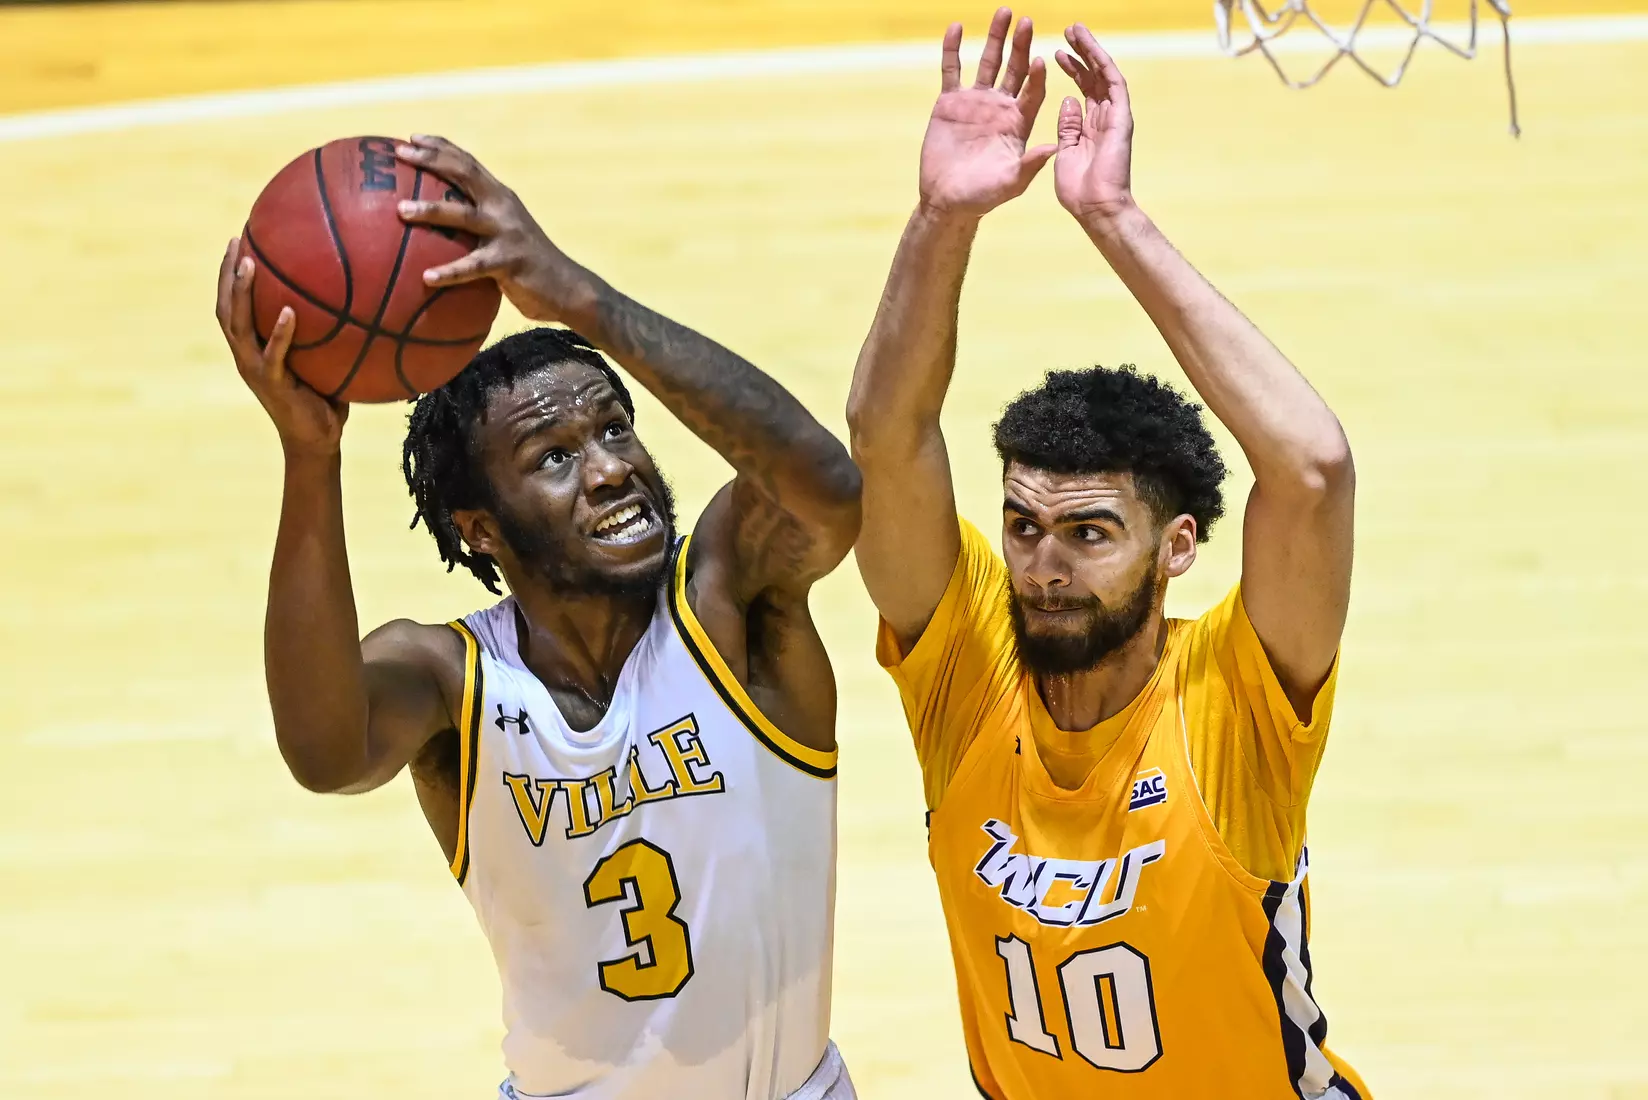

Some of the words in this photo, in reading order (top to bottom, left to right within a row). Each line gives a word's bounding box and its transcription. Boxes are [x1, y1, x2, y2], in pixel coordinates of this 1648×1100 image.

[503, 712, 725, 847] VILLE
[583, 837, 695, 1002] 3
[973, 818, 1166, 928] WCU
[994, 932, 1164, 1074] 10
